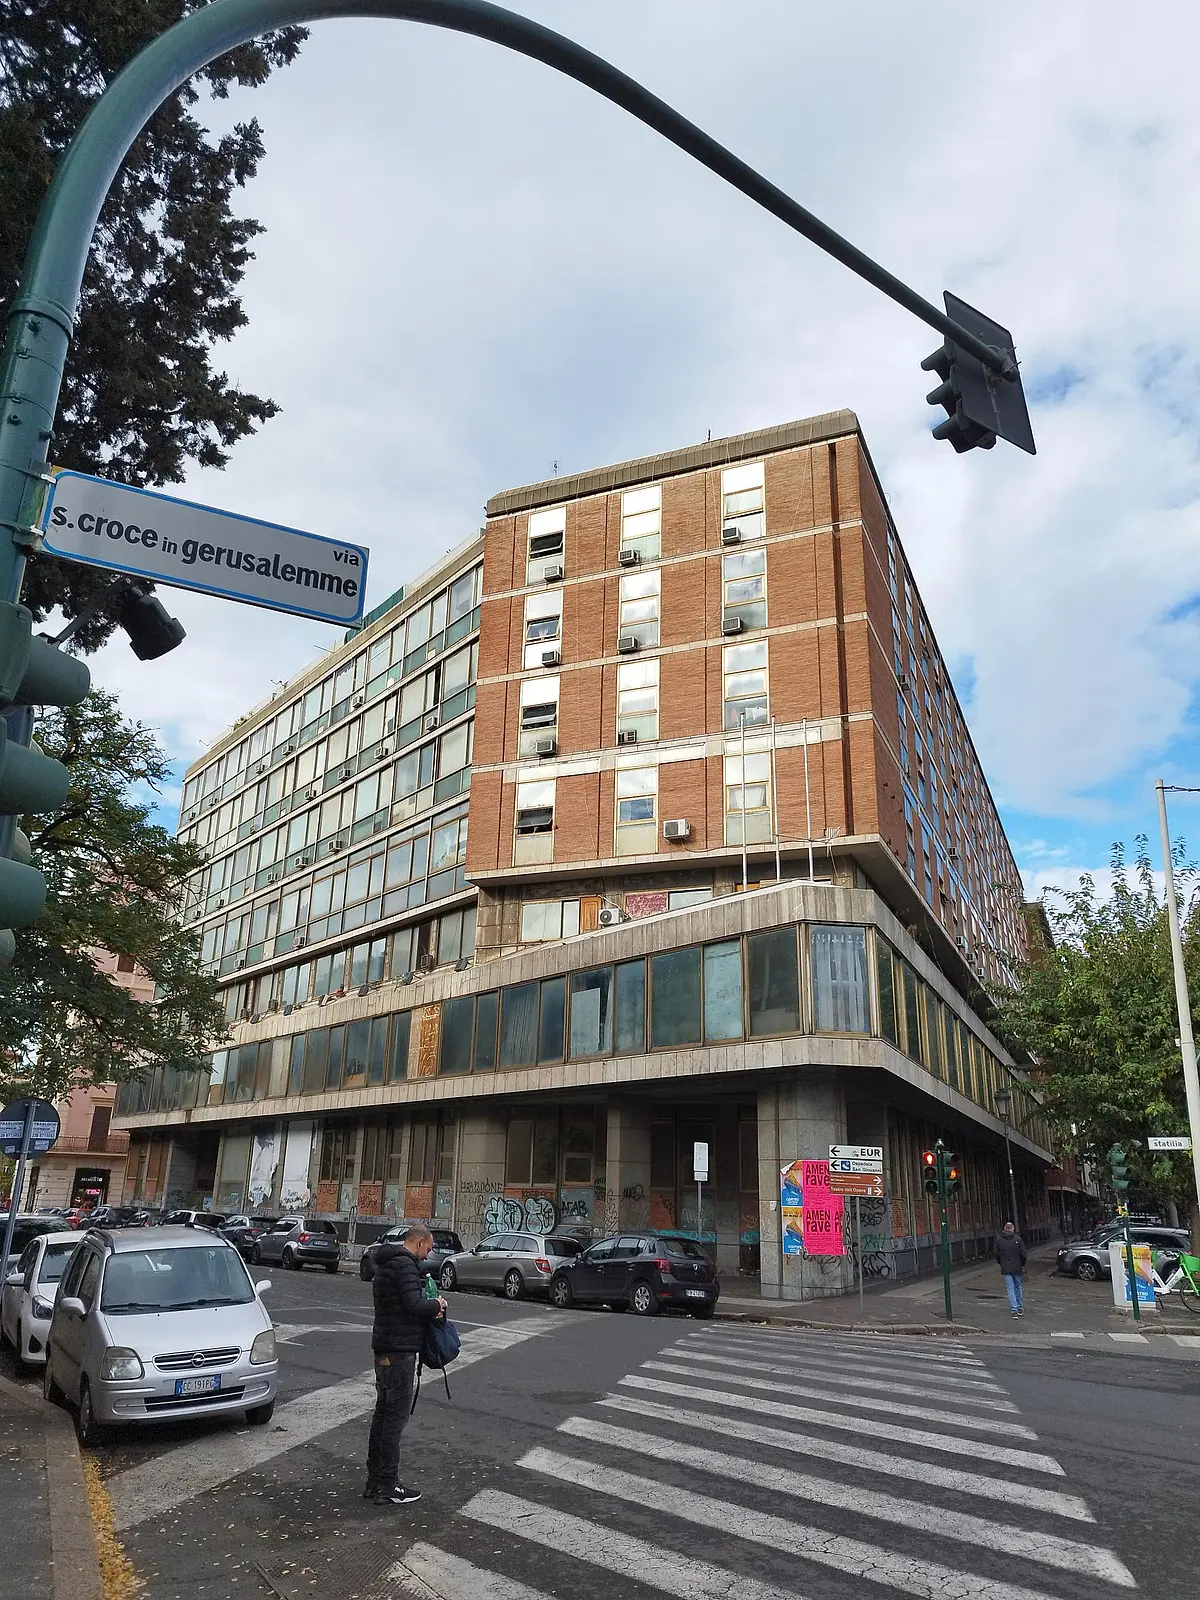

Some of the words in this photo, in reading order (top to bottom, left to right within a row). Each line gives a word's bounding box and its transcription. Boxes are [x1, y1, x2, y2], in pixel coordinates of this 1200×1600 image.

[333, 550, 360, 567] via
[162, 537, 178, 555] in
[181, 539, 358, 598] gerusalemme
[860, 1148, 881, 1157] EUR
[805, 1164, 829, 1175] AMEN
[805, 1175, 830, 1187] rave
[805, 1210, 831, 1221] AMEN
[805, 1221, 831, 1233] rave
